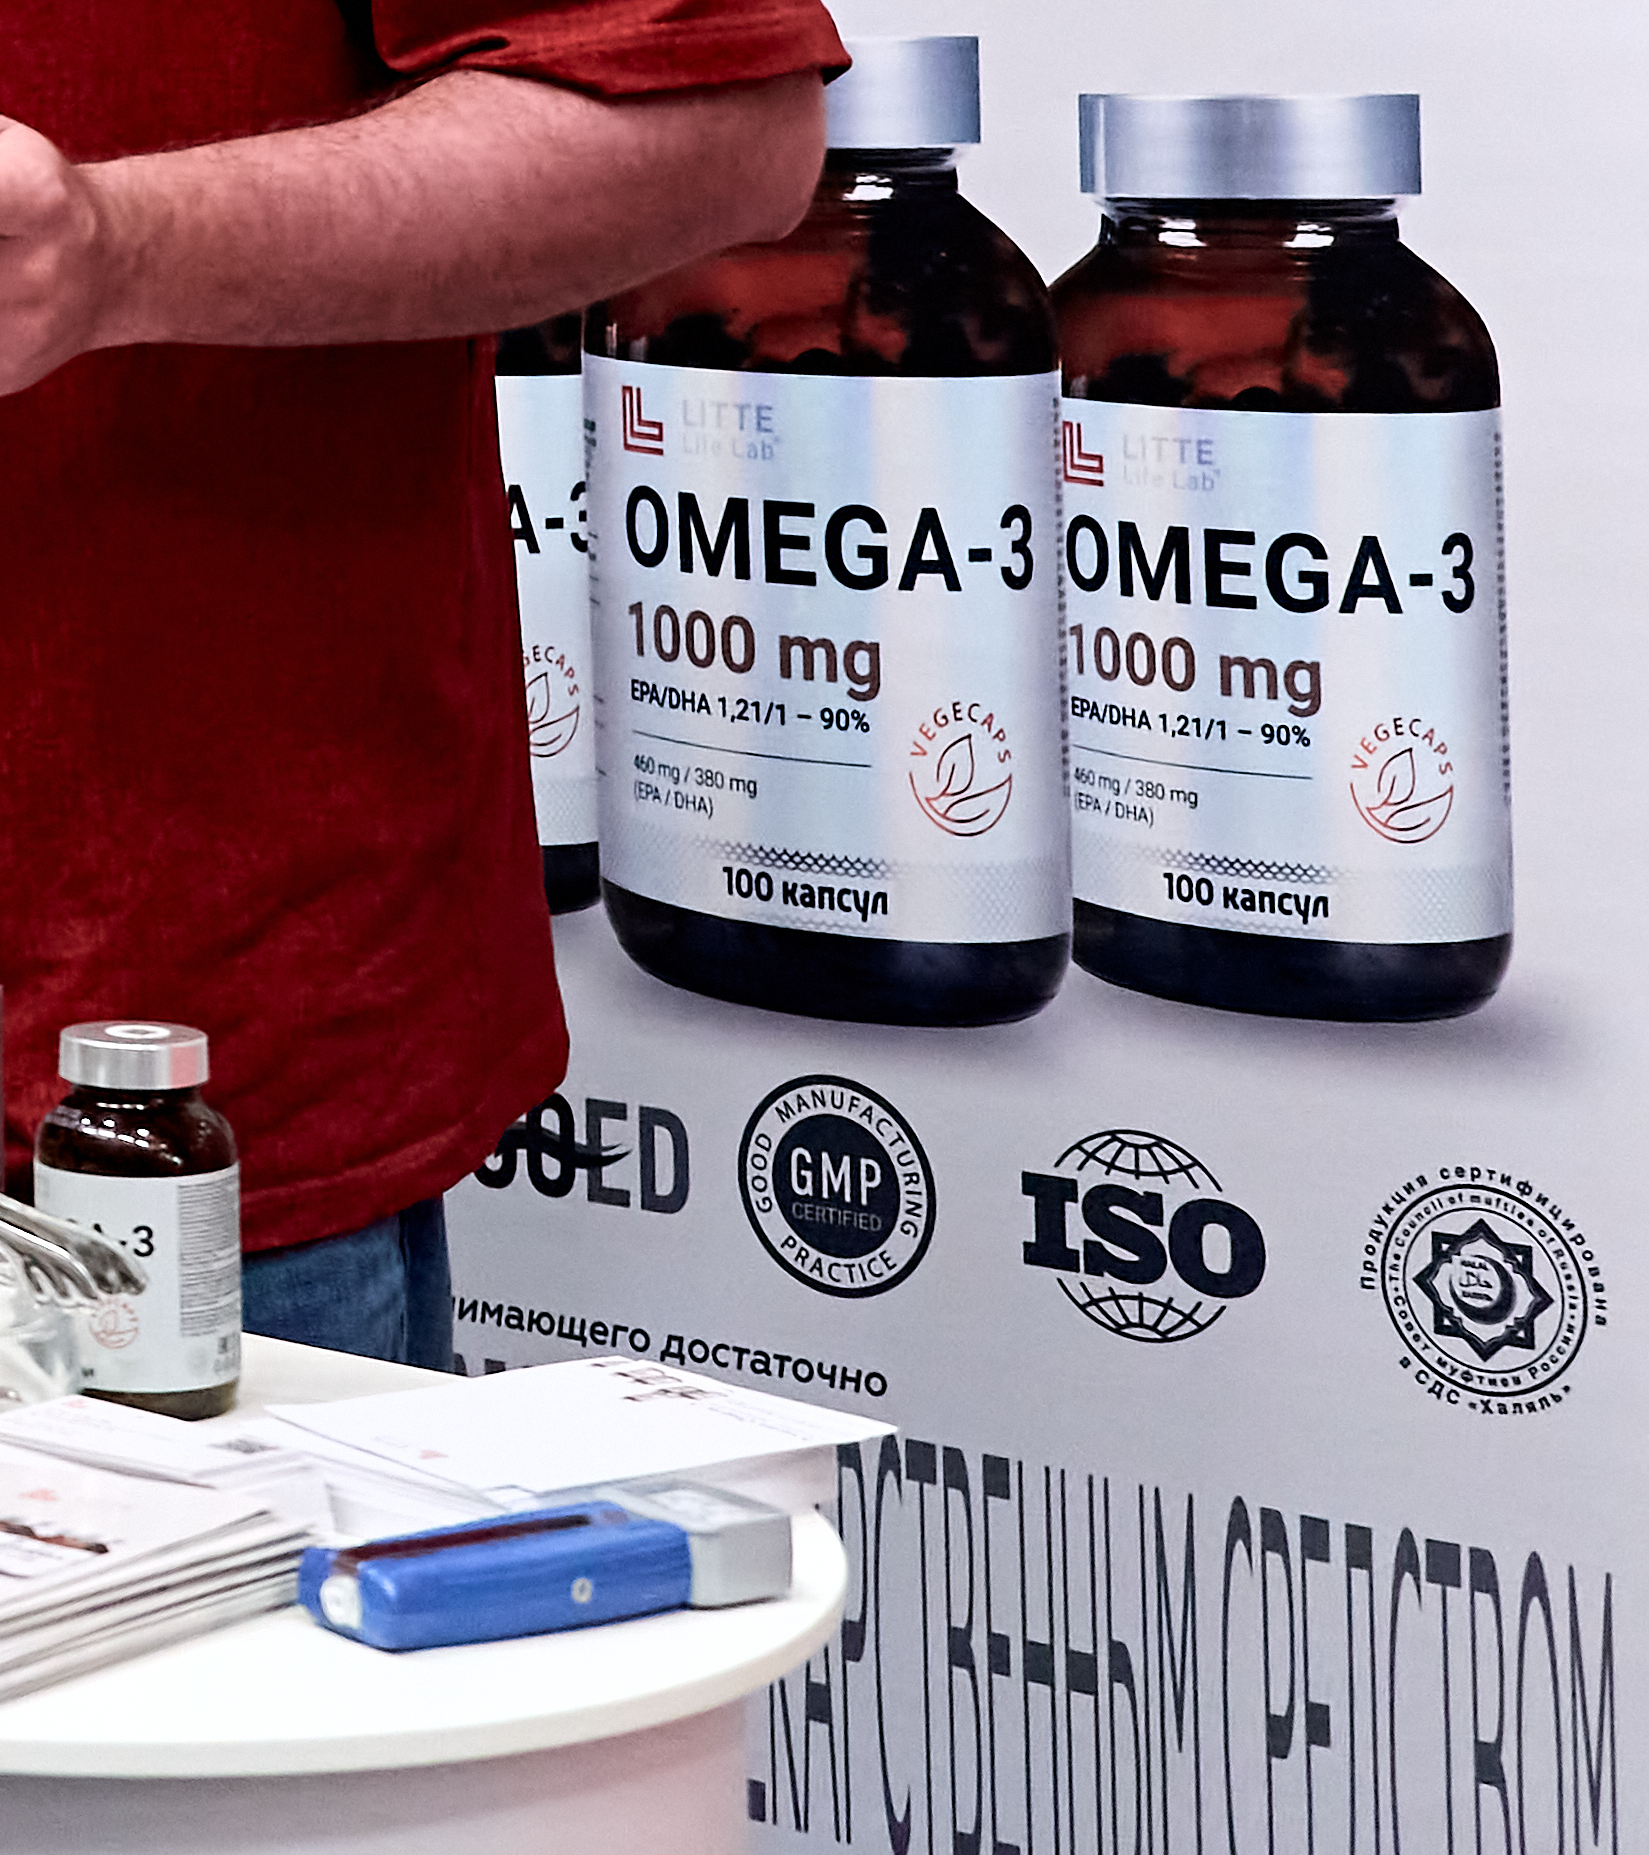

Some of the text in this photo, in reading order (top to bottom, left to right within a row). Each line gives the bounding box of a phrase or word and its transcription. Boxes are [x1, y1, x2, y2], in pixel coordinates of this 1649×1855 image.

[681, 398, 774, 434] LITTE
[624, 485, 1035, 592] OMEGA-3
[1066, 513, 1475, 614] OMEGA-3
[627, 601, 882, 701] 1000 mg
[1069, 623, 1321, 718] 1000 mg
[630, 679, 871, 734] EPA/DHA 1,21/1 90%
[909, 700, 1012, 765] VEGECAPS
[1071, 695, 1311, 748] EPA/DHA 1,21/1 90%
[1351, 716, 1454, 776] VEGECAPS
[694, 766, 725, 790] 380
[728, 776, 759, 800] mg
[1134, 778, 1165, 802] 380
[1169, 786, 1199, 810] mg
[723, 866, 889, 923] 100 капсул
[1163, 872, 1329, 925] 100 капсул
[752, 1088, 922, 1284] GOOD MANUFACTURING PRACTICE
[791, 1146, 883, 1207] GMP
[791, 1200, 883, 1232] CERTIFIED
[1021, 1171, 1266, 1299] ISO
[659, 1333, 889, 1398] достаточно
